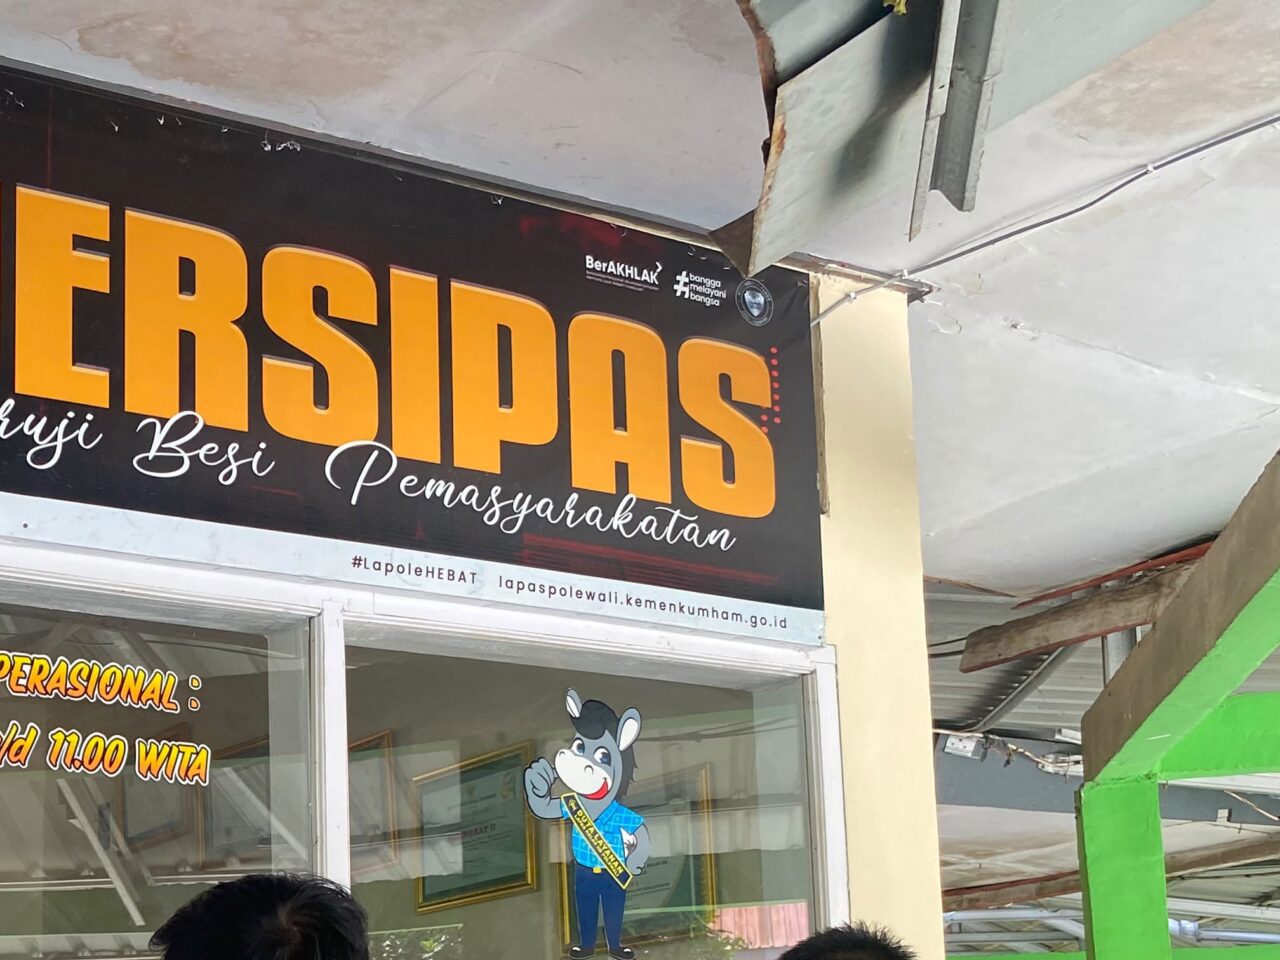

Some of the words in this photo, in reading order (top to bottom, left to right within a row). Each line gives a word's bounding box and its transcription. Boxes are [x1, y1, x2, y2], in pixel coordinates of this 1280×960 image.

[585, 254, 662, 285] BerAKHLAK
[131, 410, 276, 486] Besi
[324, 440, 737, 552] Pemasyarakatan
[351, 554, 478, 585] #LapoleHEBAT
[498, 574, 789, 630] lapaspolewali.kemenkumham.go.id
[46, 727, 129, 777] 11.00
[135, 738, 211, 787] WITA
[593, 833, 624, 876] LAYANAN
